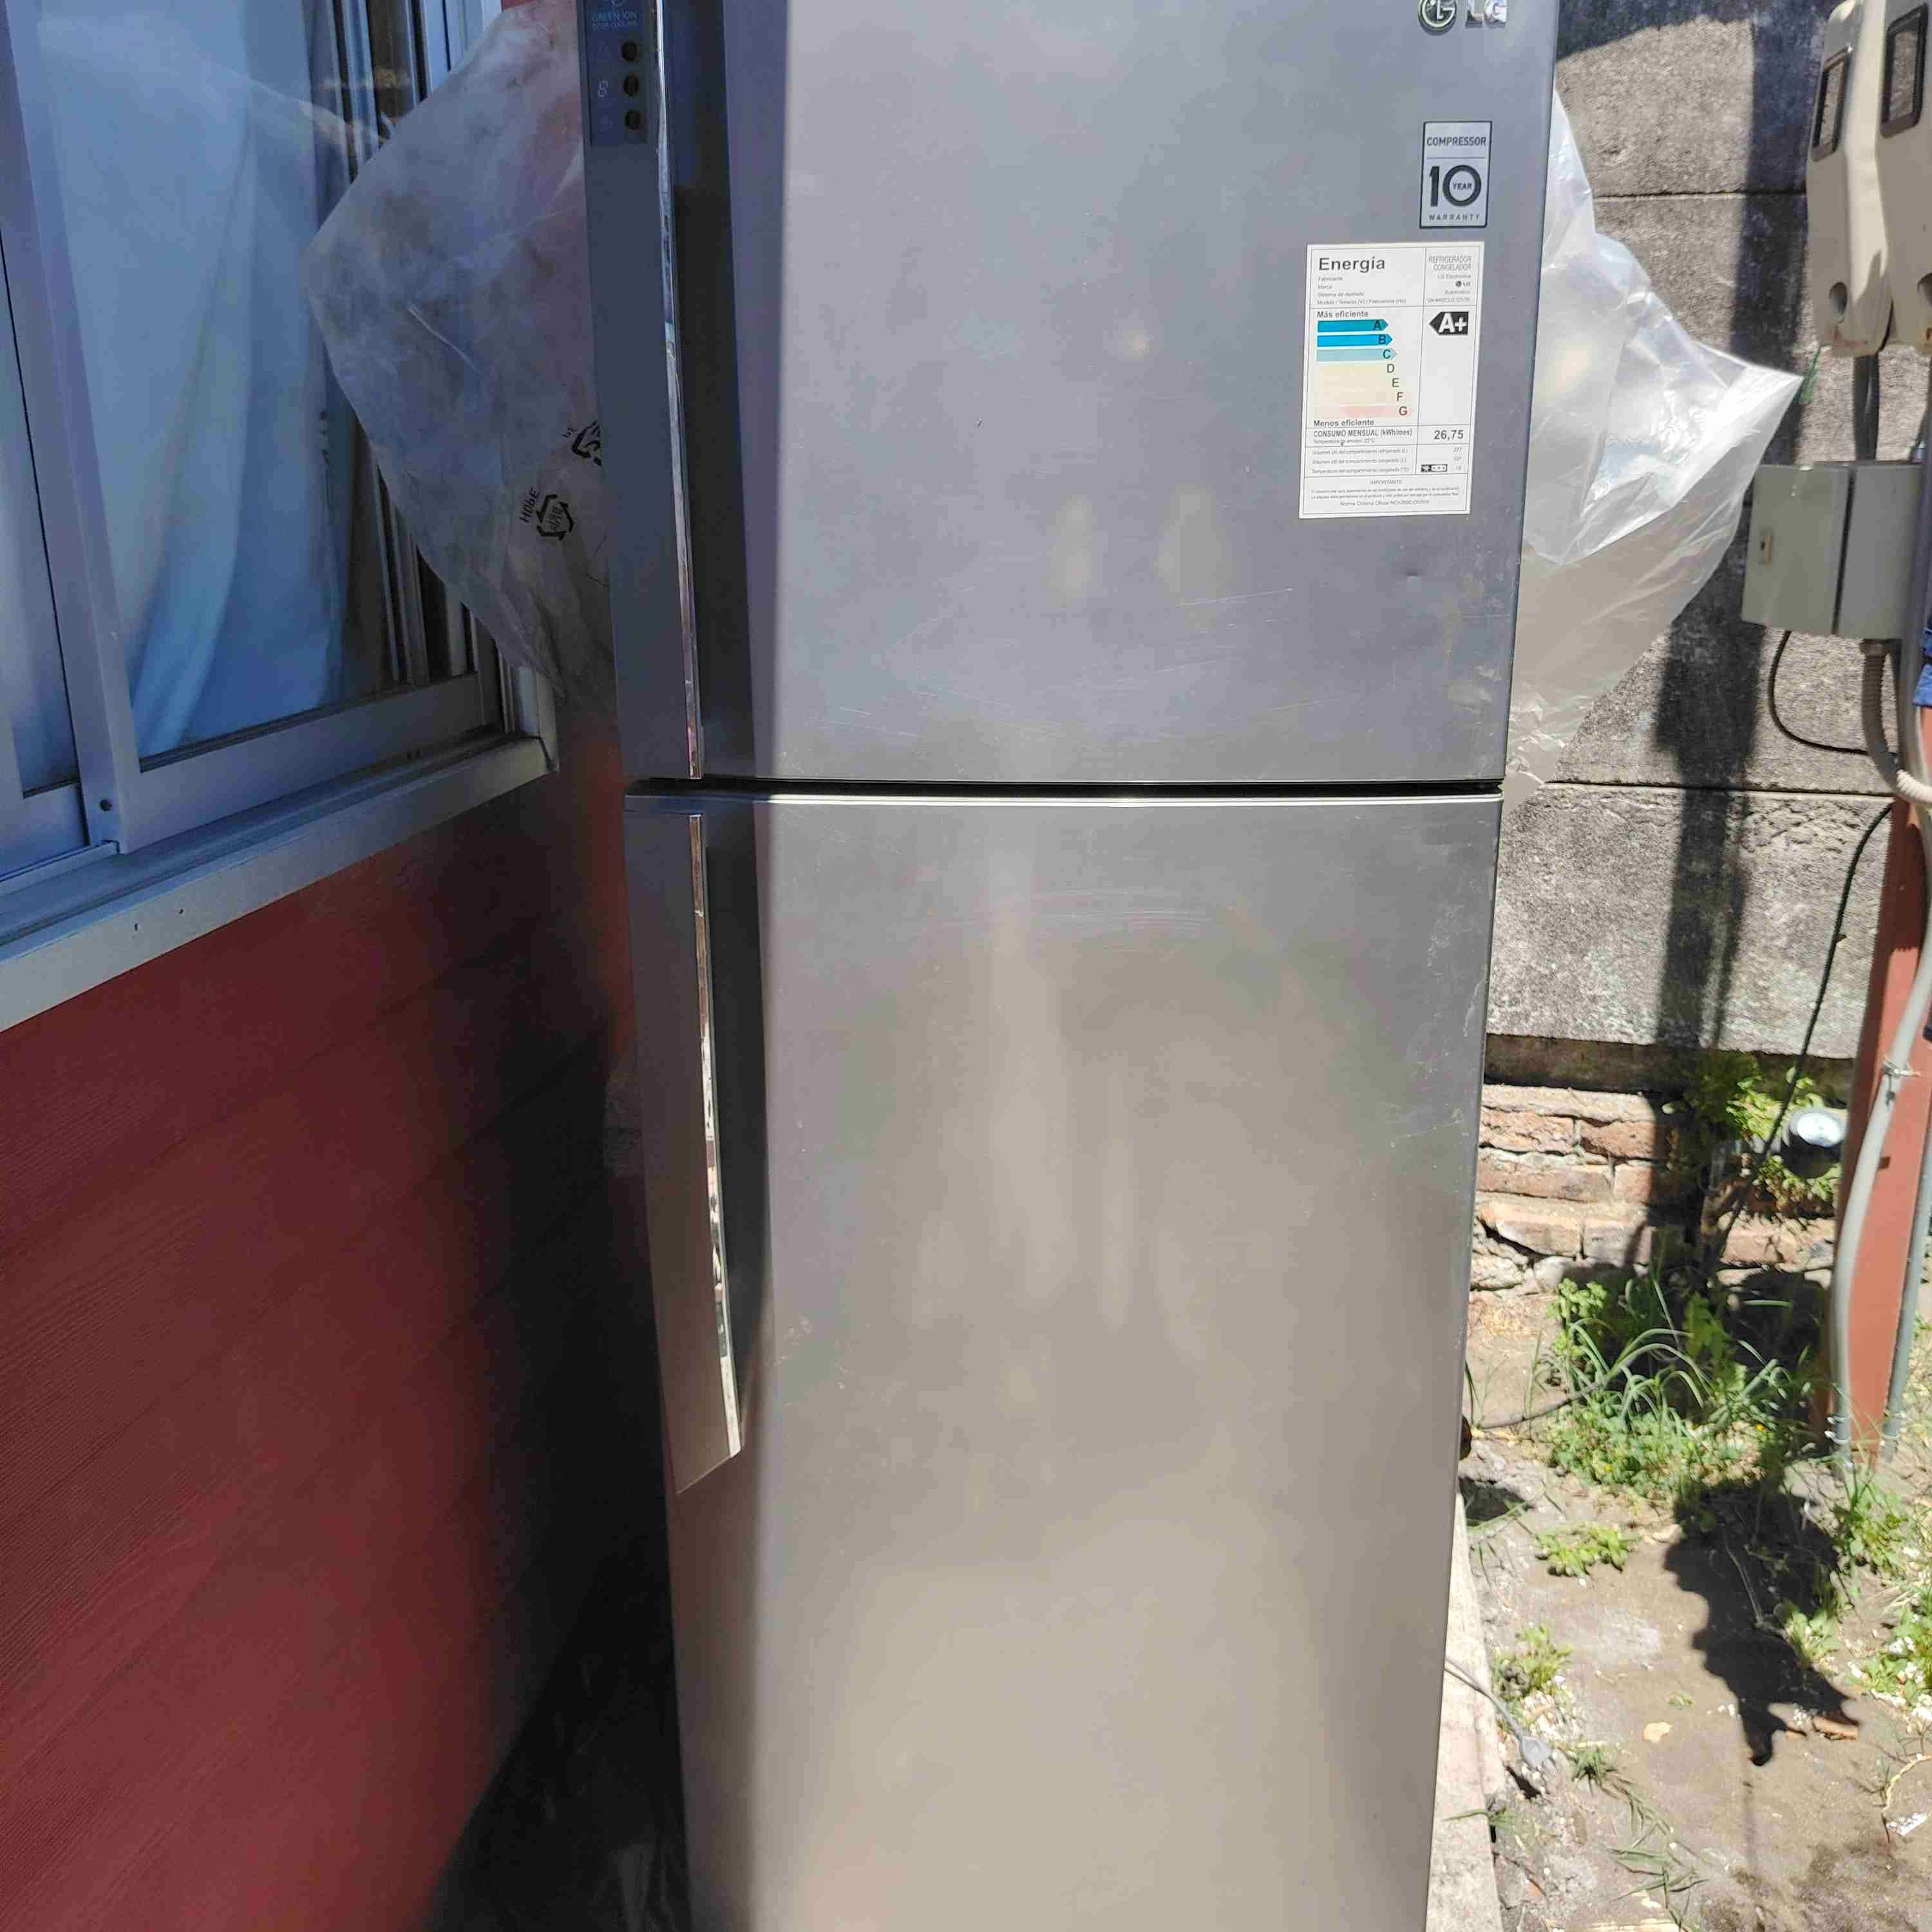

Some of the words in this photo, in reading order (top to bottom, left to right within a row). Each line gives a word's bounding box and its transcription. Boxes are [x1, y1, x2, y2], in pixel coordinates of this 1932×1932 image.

[1466, 0, 1507, 23] LG
[1426, 136, 1487, 147] COMPRESSOR
[1429, 164, 1482, 207] 10
[1428, 213, 1480, 222] WARRANTY
[1318, 256, 1385, 274] Energía
[1317, 310, 1333, 319] Más
[1335, 309, 1369, 319] eficiente
[1373, 319, 1382, 331] A
[1437, 312, 1468, 334] A+
[1378, 334, 1387, 345] B
[1382, 349, 1391, 359] C
[1386, 363, 1396, 374] D
[1392, 377, 1400, 388] E
[1396, 392, 1404, 402] F
[1399, 406, 1408, 416] G
[1341, 419, 1374, 427] eficiente
[1313, 430, 1347, 438] CONSUMO
[1434, 429, 1464, 441] 26,75
